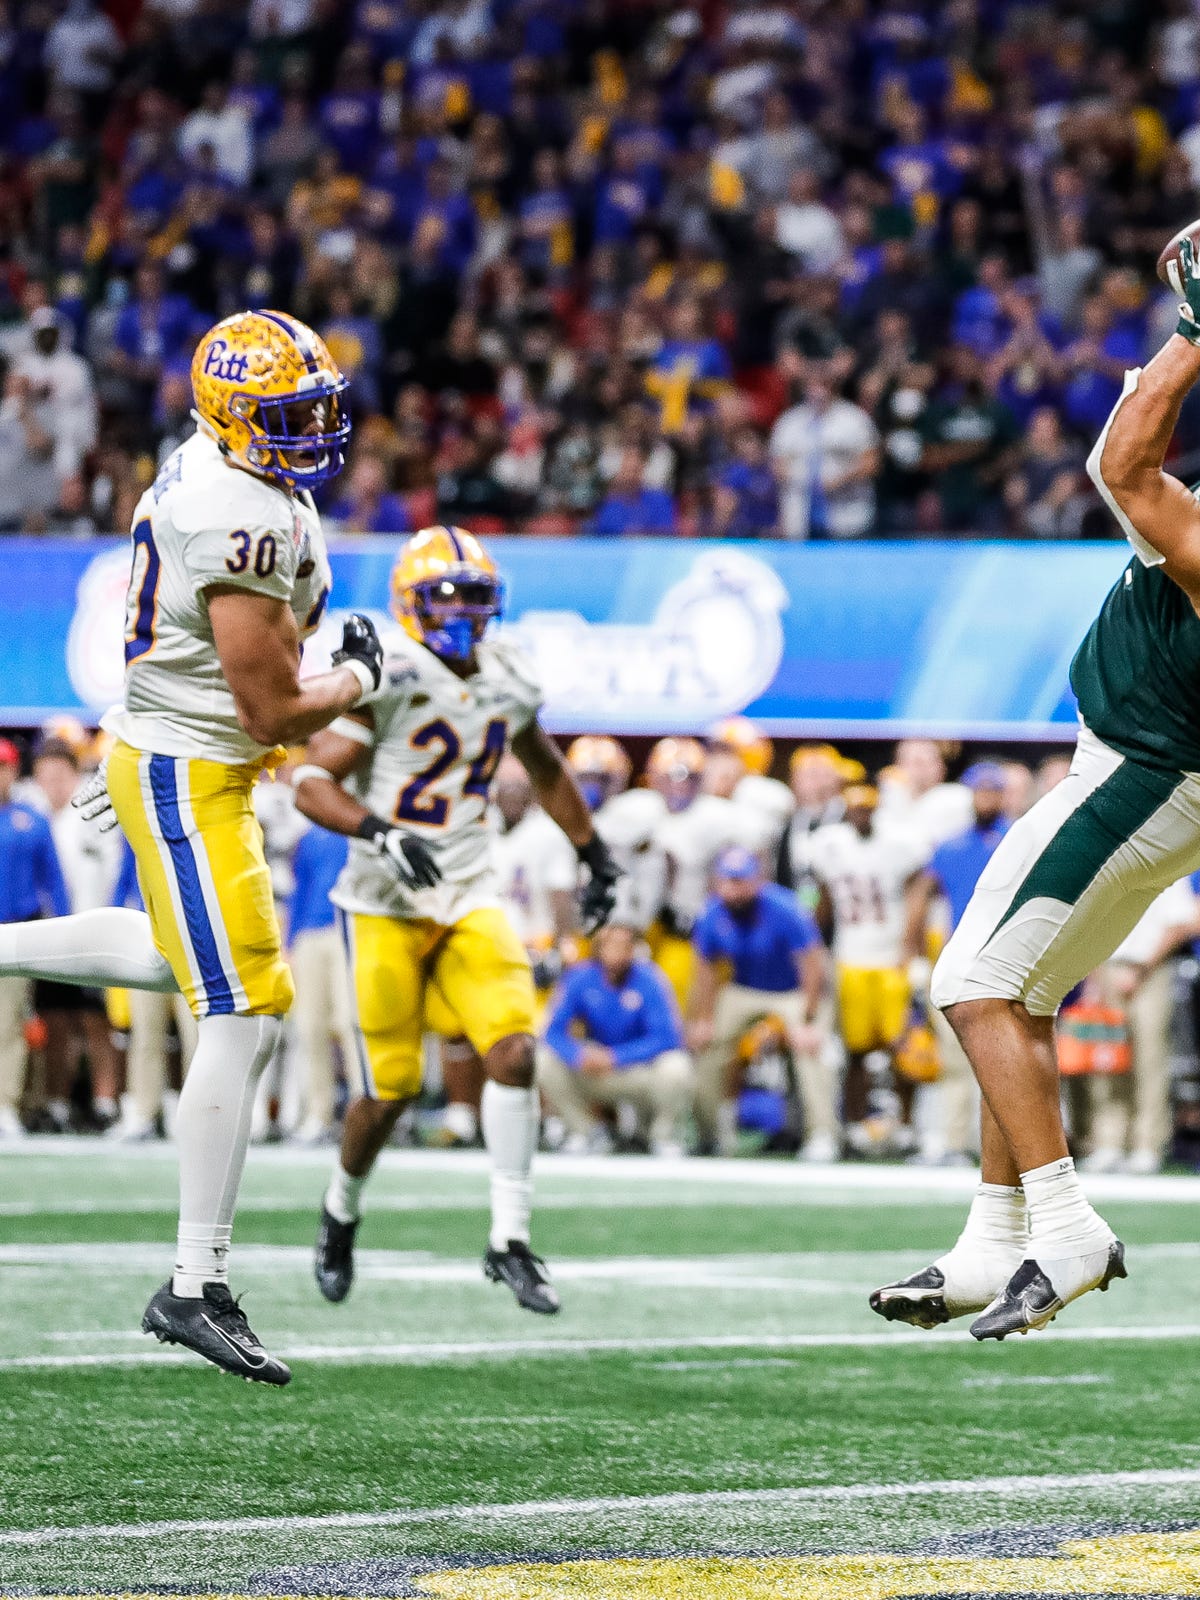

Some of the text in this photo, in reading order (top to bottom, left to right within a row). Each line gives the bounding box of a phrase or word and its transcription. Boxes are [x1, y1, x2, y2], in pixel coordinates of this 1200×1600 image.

[204, 340, 248, 383] Pitt
[226, 529, 277, 578] 30
[394, 716, 509, 828] 24
